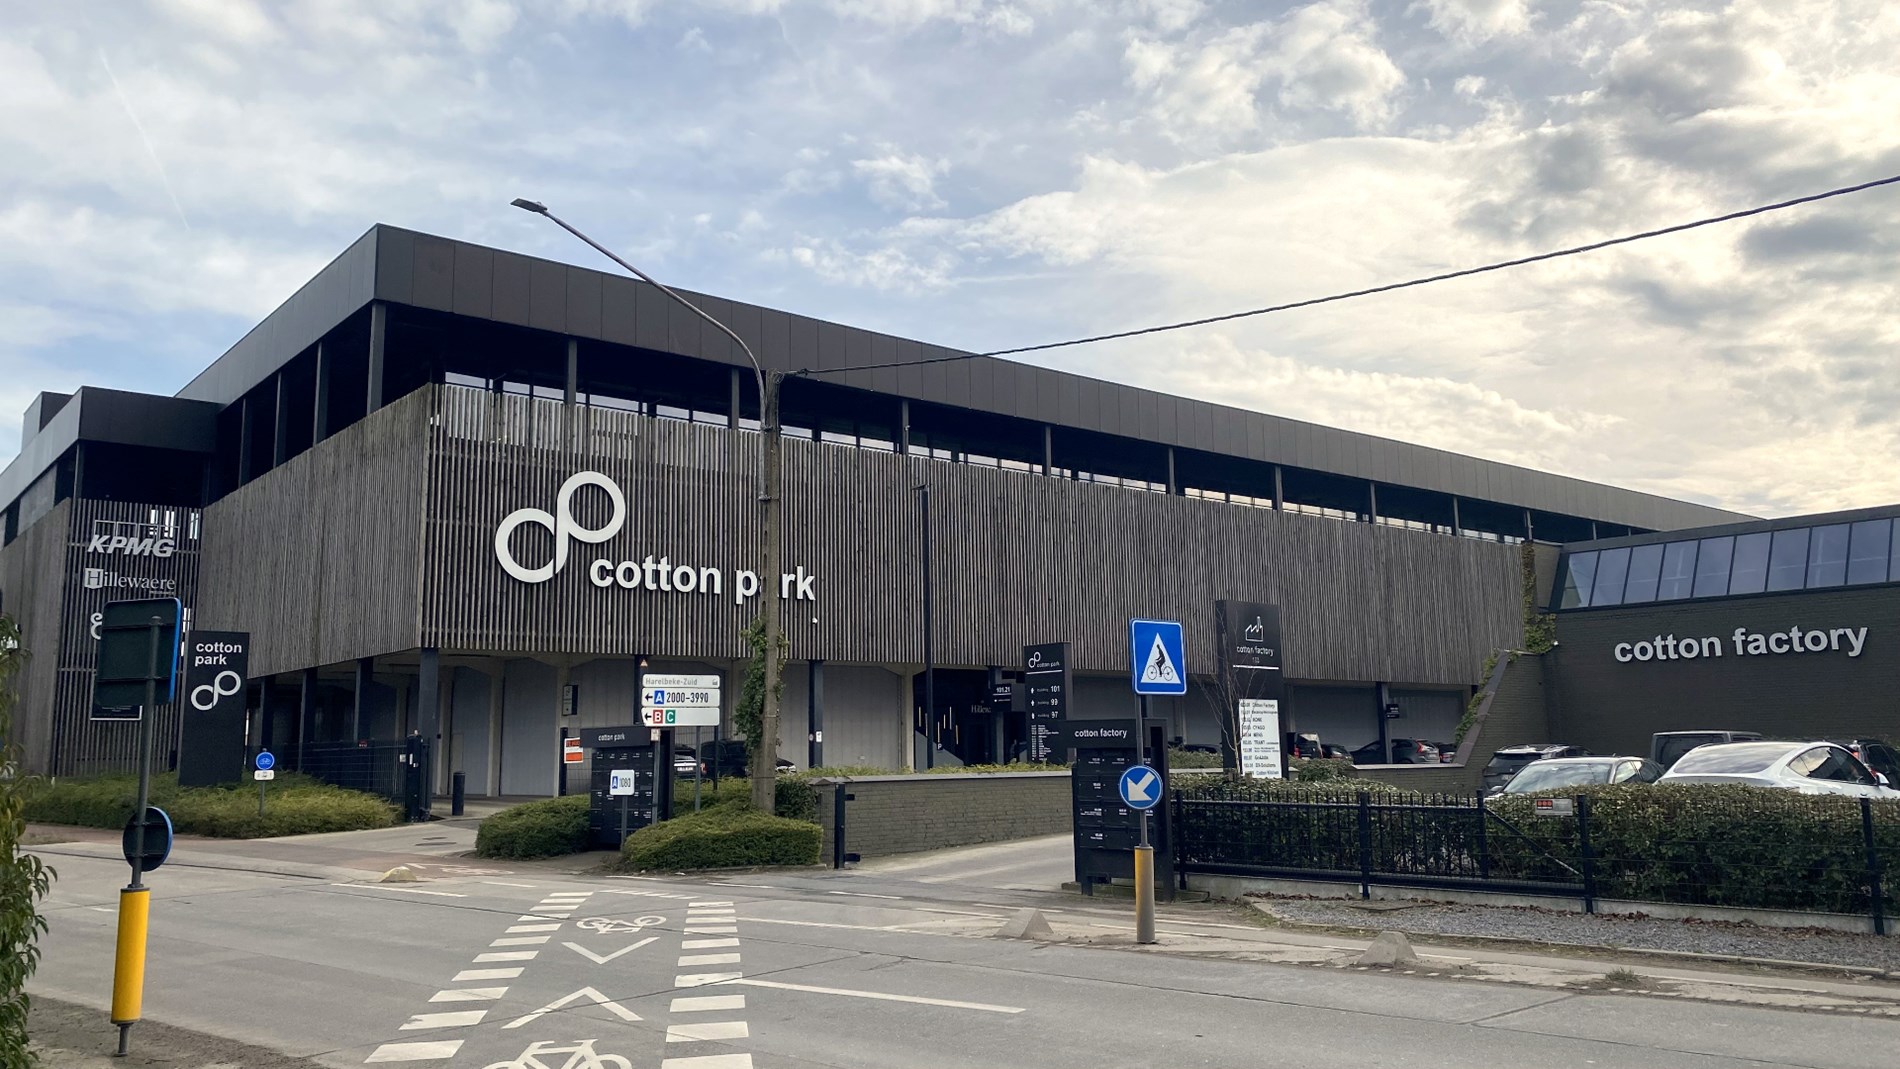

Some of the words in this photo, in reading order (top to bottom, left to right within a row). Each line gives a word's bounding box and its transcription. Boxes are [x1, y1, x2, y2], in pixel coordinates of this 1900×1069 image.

[87, 534, 175, 558] KPMG
[84, 567, 176, 590] Hillewaere
[589, 555, 722, 595] cotton
[735, 565, 816, 606] prk
[195, 641, 243, 654] cotton
[1614, 633, 1723, 663] cotton
[1732, 625, 1868, 658] factory
[1236, 646, 1254, 654] cotton
[1254, 646, 1274, 657] factory
[194, 654, 228, 667] park
[645, 677, 698, 685] Harelbeke-Zuid
[1050, 685, 1060, 693] 101
[655, 692, 664, 703] A
[666, 692, 709, 703] 2000-3990
[1050, 698, 1058, 706] 99
[666, 711, 674, 722] C
[614, 733, 626, 742] park
[1074, 729, 1099, 738] cotton
[1100, 728, 1128, 739] factory
